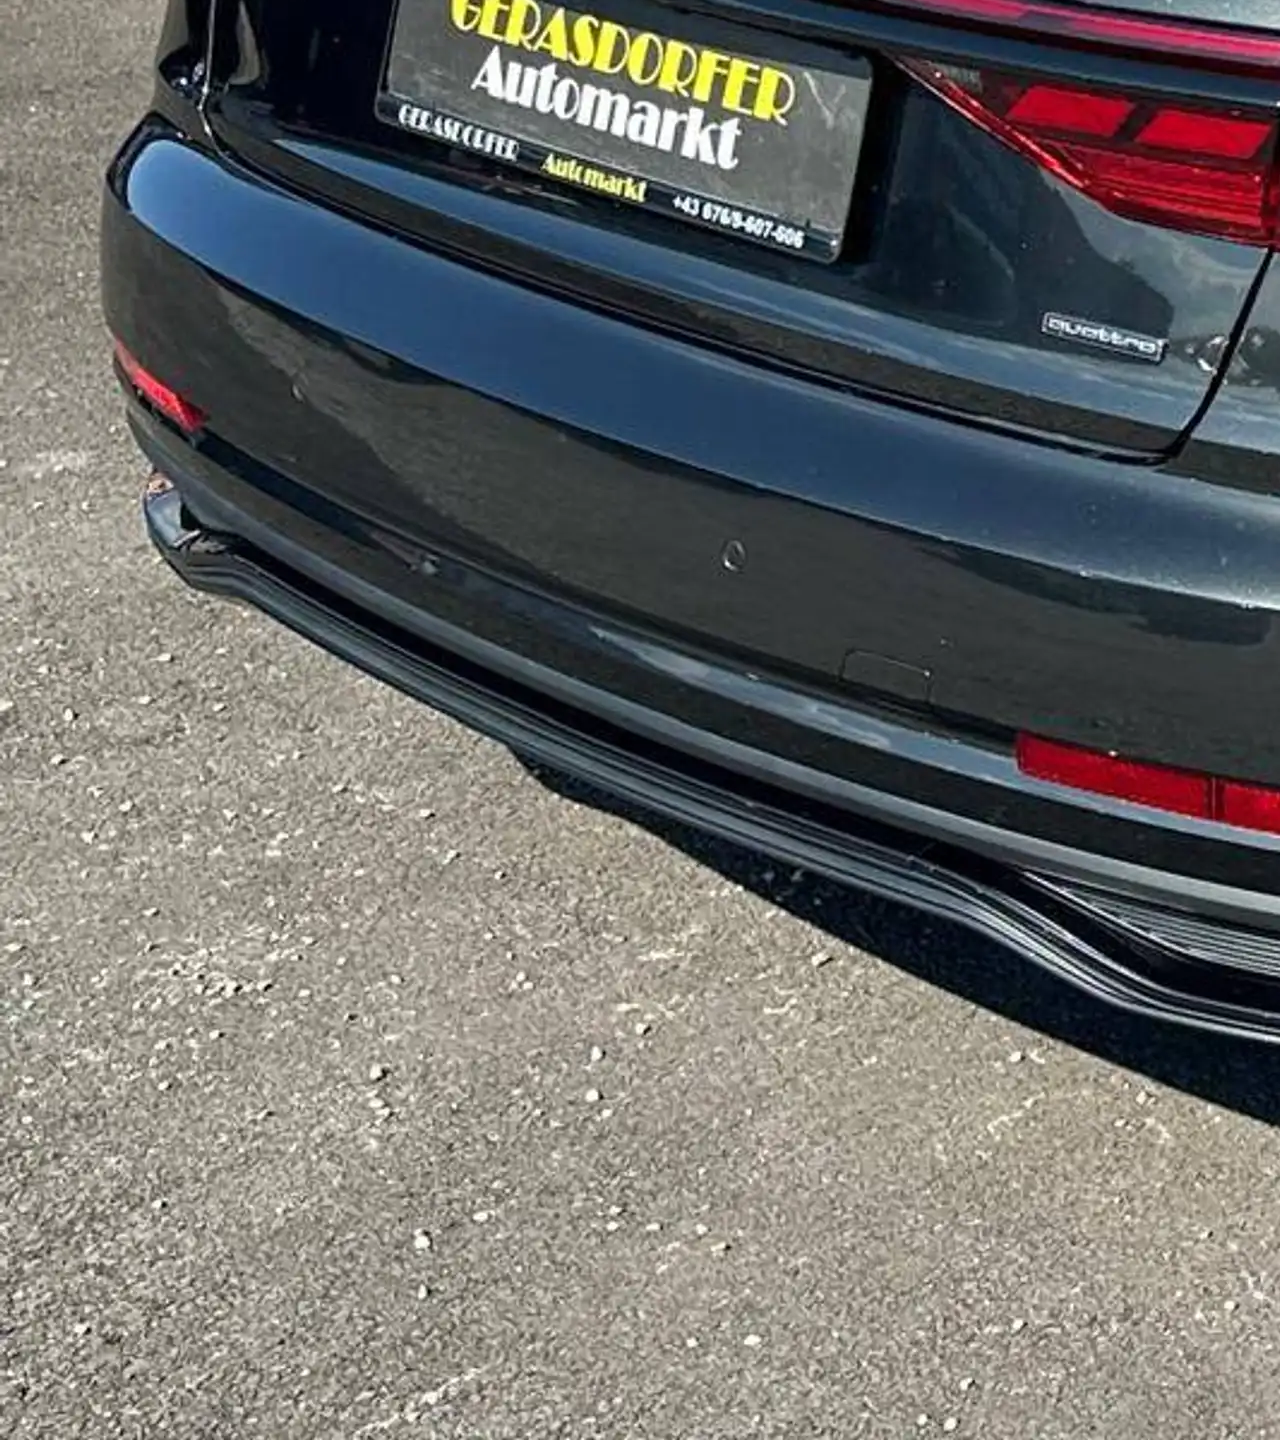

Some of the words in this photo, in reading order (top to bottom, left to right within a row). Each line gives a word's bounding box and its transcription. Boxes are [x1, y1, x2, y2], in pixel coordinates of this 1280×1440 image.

[398, 103, 521, 162] GERASDORFER
[540, 153, 649, 203] Automarkt
[672, 194, 701, 218] +43
[470, 45, 742, 171] Automarkt
[1048, 316, 1157, 355] quattro
